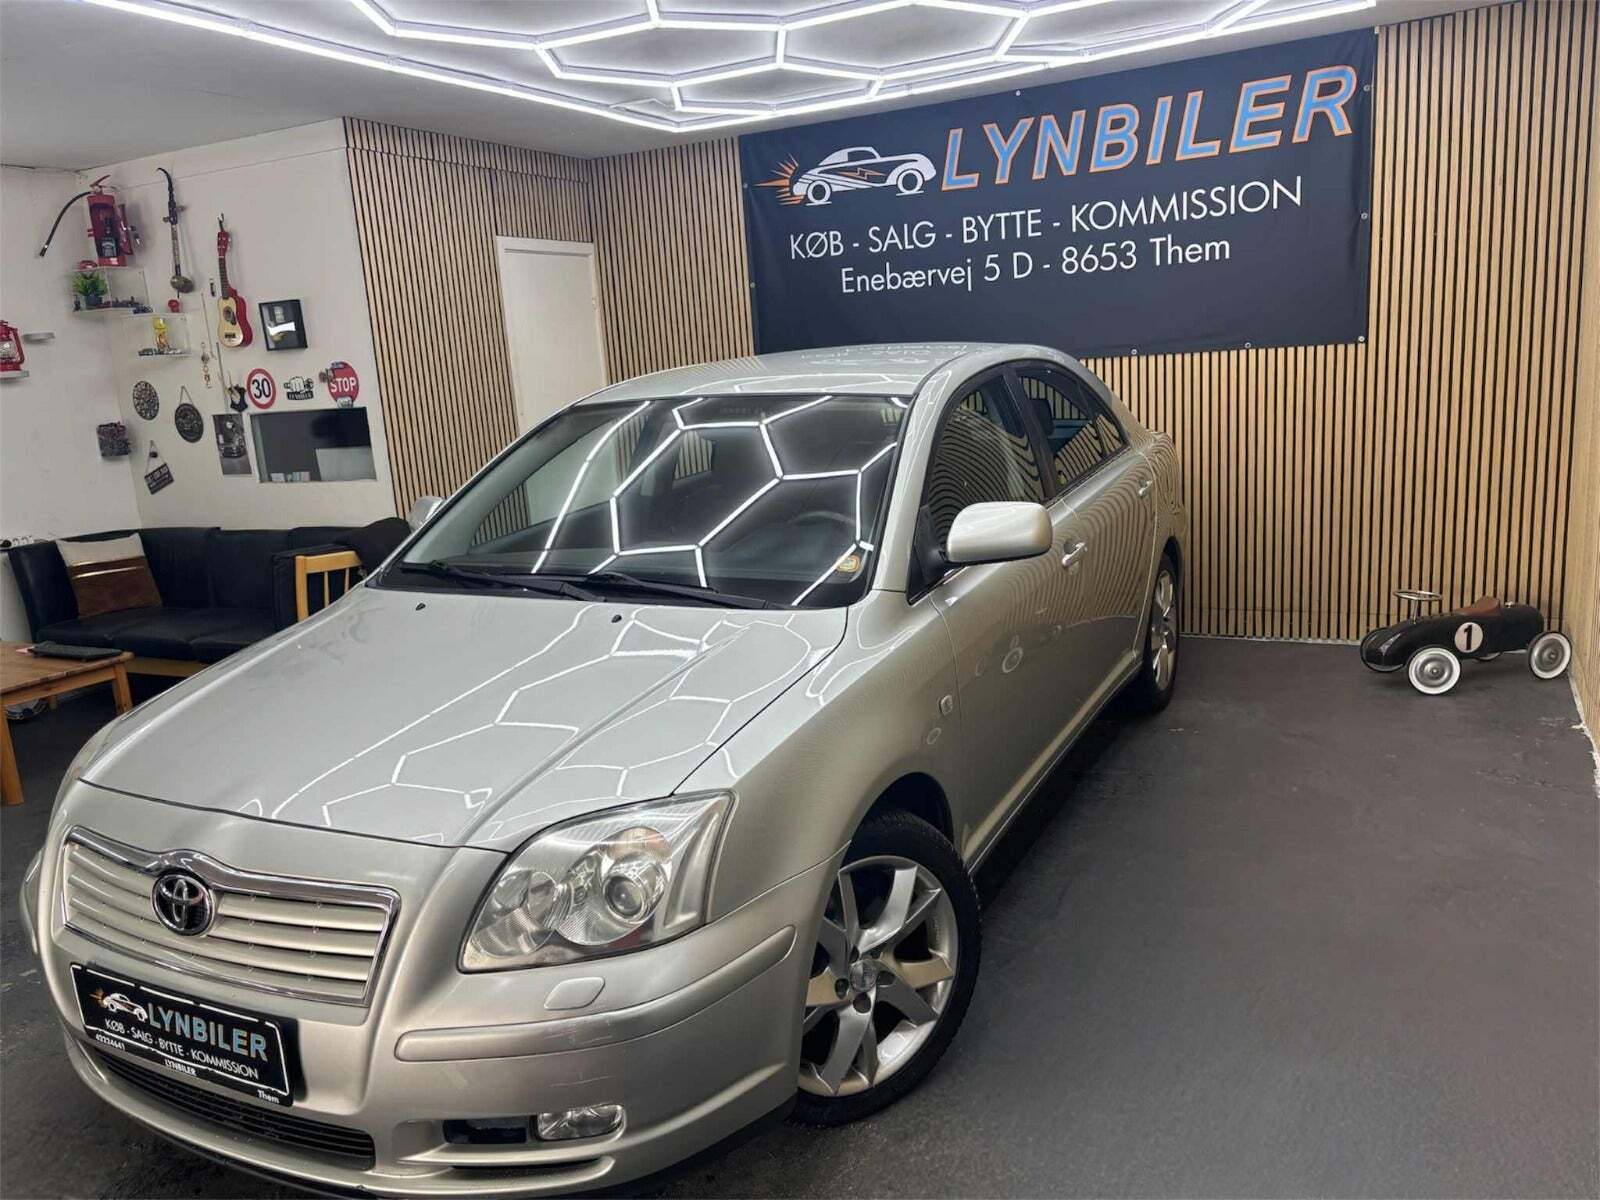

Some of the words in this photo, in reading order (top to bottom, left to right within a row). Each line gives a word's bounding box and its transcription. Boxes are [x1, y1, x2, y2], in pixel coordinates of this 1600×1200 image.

[941, 64, 1358, 191] LYNBILER
[790, 230, 844, 260] KØB
[868, 220, 936, 253] SALG
[962, 208, 1042, 244] BYTTE
[1071, 175, 1302, 233] KOMMISSION
[841, 258, 973, 293] Enebærvej
[983, 253, 1001, 282] 5
[1013, 251, 1033, 279] D
[1061, 240, 1137, 275] 8653
[1149, 234, 1230, 266] Them
[252, 378, 271, 399] 30
[330, 376, 357, 393] STOP
[1464, 624, 1472, 650] 1
[105, 1018, 125, 1034] KØB
[131, 1026, 153, 1044] SALG
[158, 1038, 184, 1057] BYTTE
[191, 1048, 259, 1081] KOMMISSION
[147, 1002, 268, 1062] LYNBILER
[164, 1058, 197, 1076] LYNBILER
[257, 1089, 280, 1104] Them
